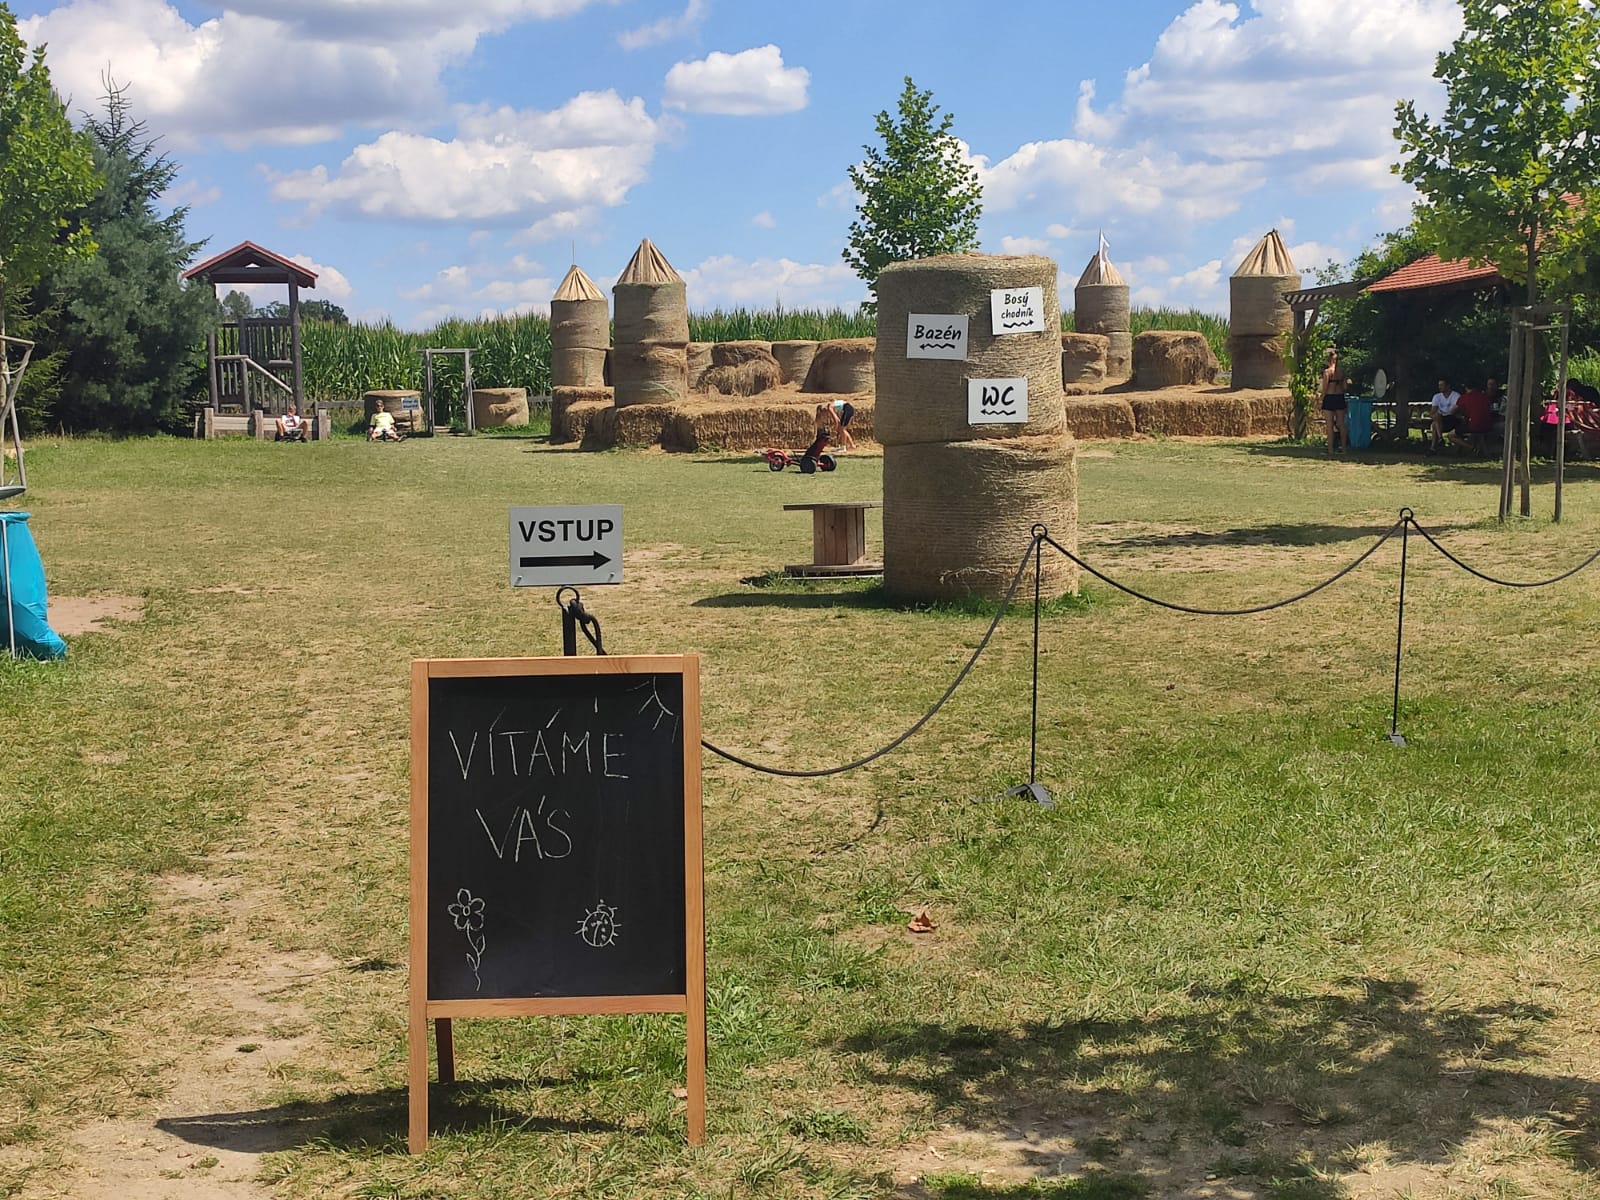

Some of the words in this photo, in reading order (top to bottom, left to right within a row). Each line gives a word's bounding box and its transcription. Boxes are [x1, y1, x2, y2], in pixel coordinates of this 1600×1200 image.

[1004, 292, 1029, 307] Bosý
[1001, 308, 1034, 319] chodník
[914, 325, 962, 340] Bazén
[982, 386, 1015, 406] WC
[518, 519, 614, 542] VSTUP
[449, 706, 629, 780] VÍTÁME
[475, 795, 572, 862] VÁS
